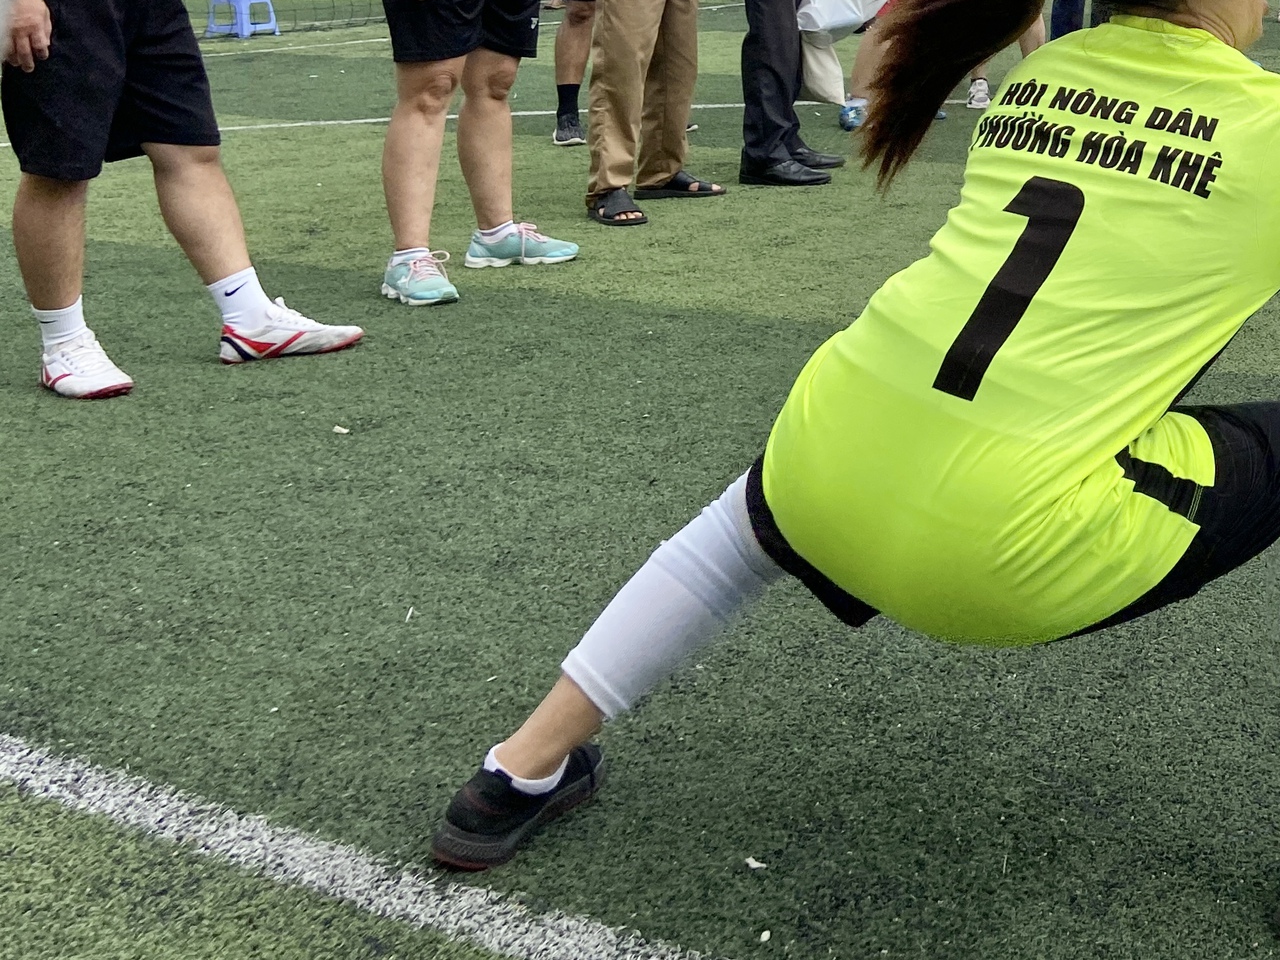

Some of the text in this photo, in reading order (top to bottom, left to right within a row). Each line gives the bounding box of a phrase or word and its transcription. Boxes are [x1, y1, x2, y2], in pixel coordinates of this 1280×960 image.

[998, 78, 1219, 142] HỘI NÔNG DÂN
[1075, 130, 1147, 175] HÒA
[1148, 146, 1223, 199] KHÊ
